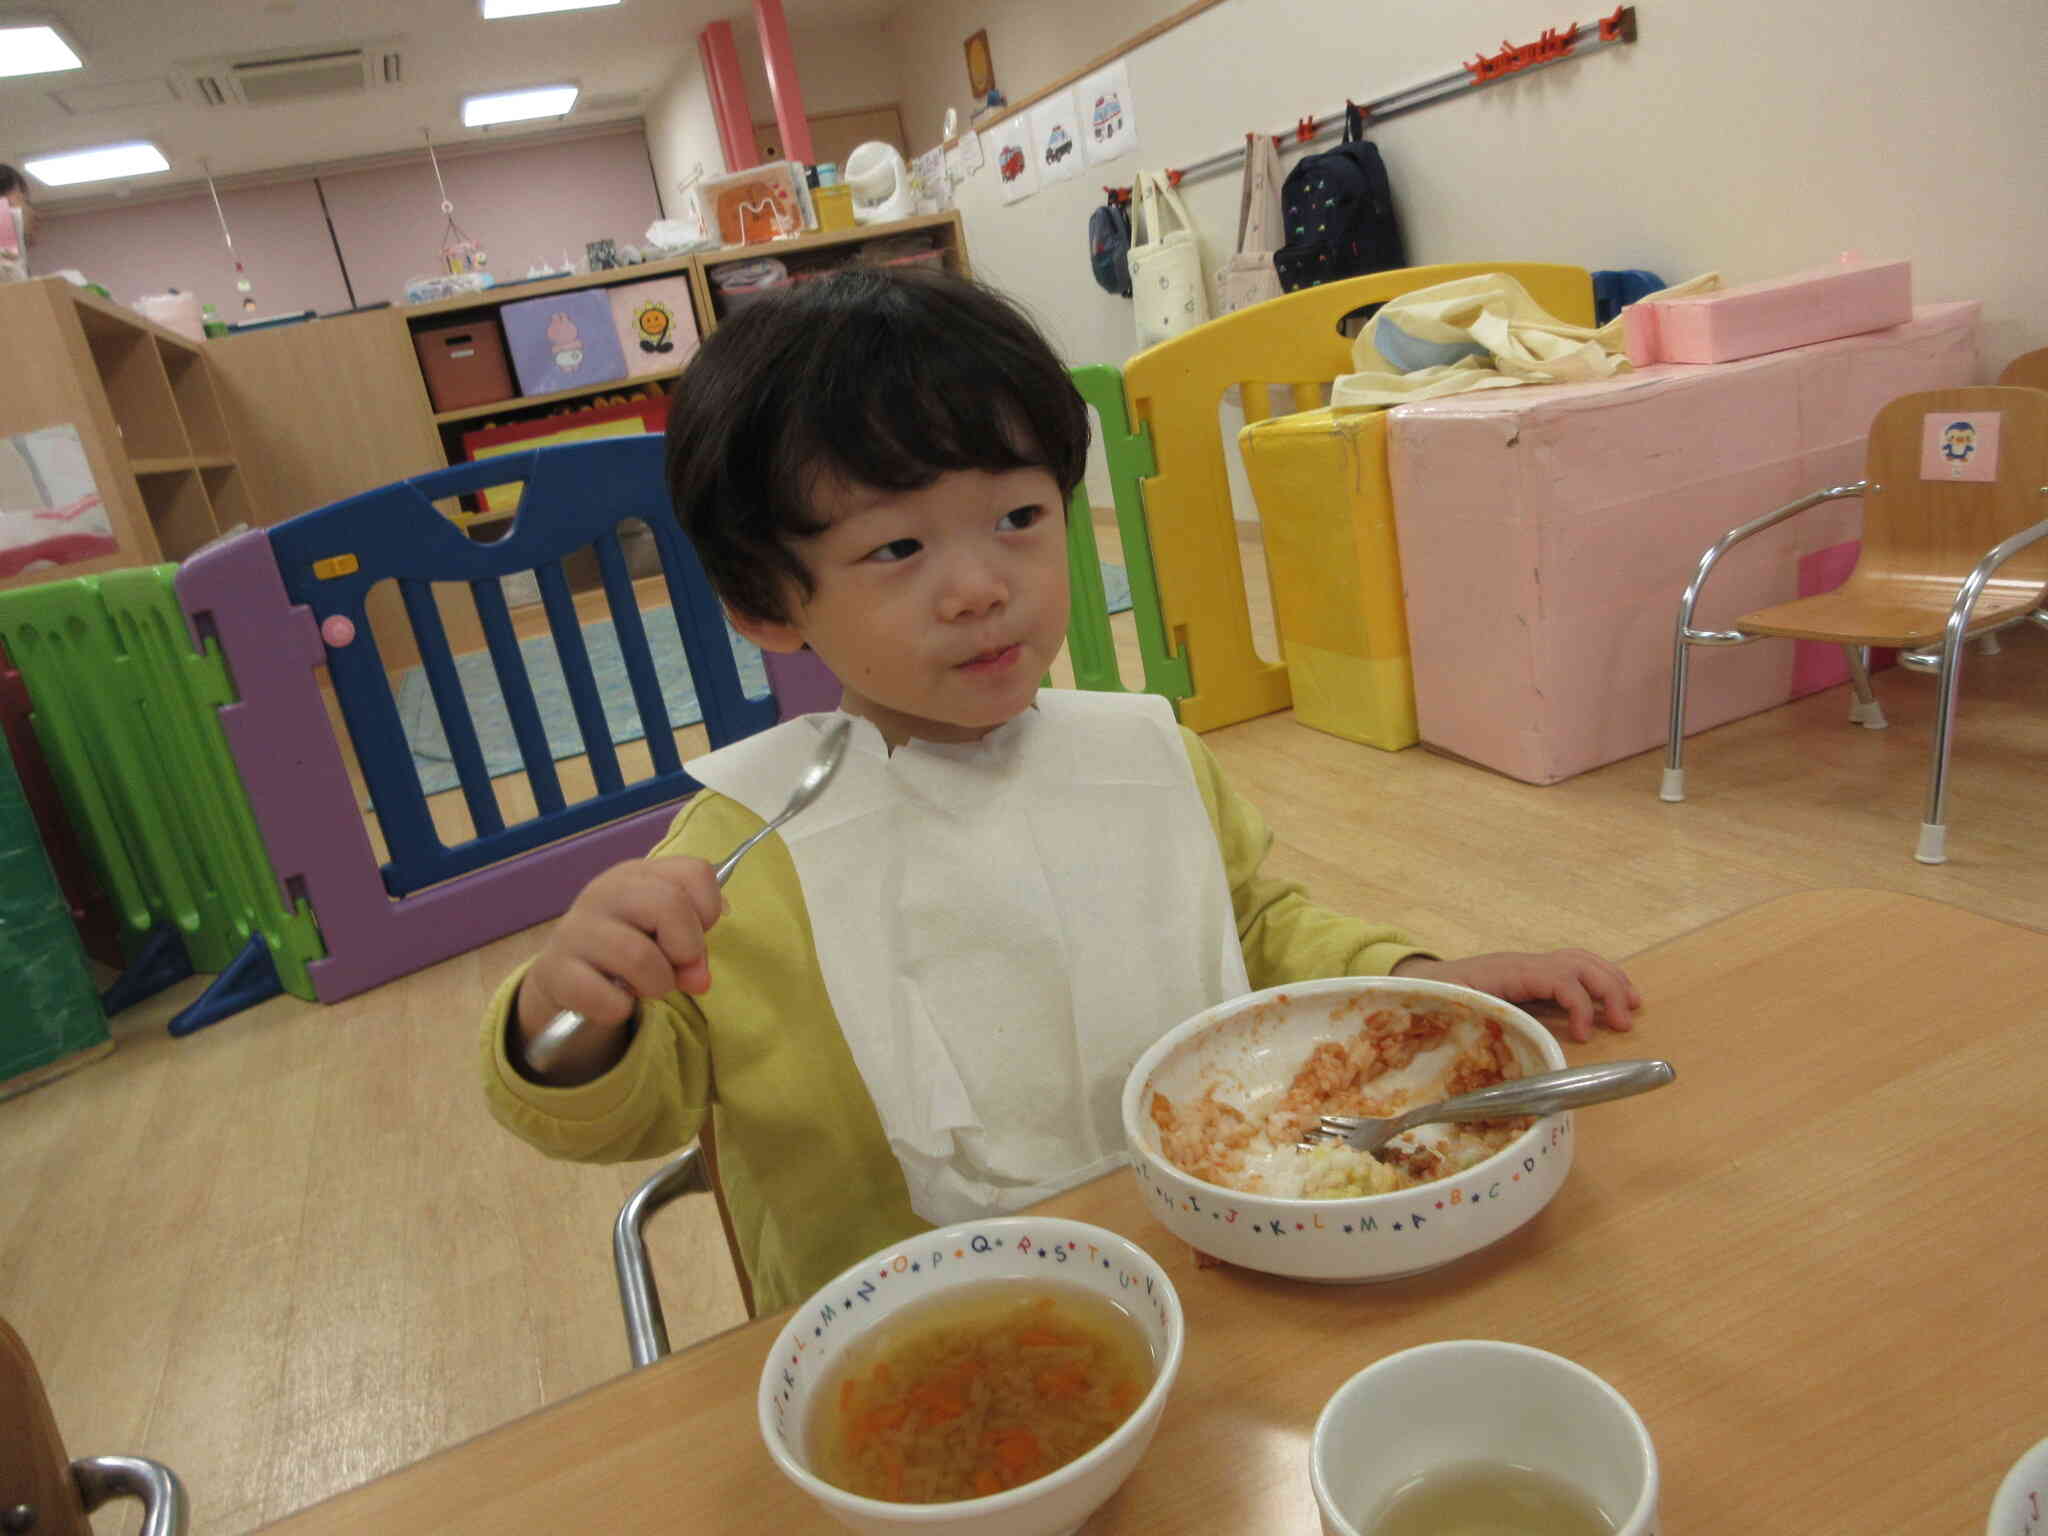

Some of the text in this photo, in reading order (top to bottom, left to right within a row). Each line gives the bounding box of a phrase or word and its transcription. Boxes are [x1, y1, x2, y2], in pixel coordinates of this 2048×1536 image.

[1225, 1208, 1239, 1223] J
[1270, 1219, 1286, 1236] K
[1313, 1213, 1324, 1229] L
[1360, 1216, 1378, 1232] M
[1411, 1213, 1426, 1229] A
[1451, 1188, 1463, 1205] B
[1488, 1182, 1500, 1199] C
[1523, 1157, 1535, 1172] D
[793, 1335, 807, 1351] L
[820, 1303, 837, 1327] M
[857, 1280, 876, 1302] N
[893, 1255, 908, 1273] O
[932, 1251, 943, 1269] P
[971, 1235, 992, 1253] Q
[1017, 1236, 1032, 1254] R
[1054, 1245, 1067, 1262] S
[1088, 1244, 1100, 1264] T
[1120, 1272, 1129, 1289] U
[1146, 1275, 1154, 1296] V
